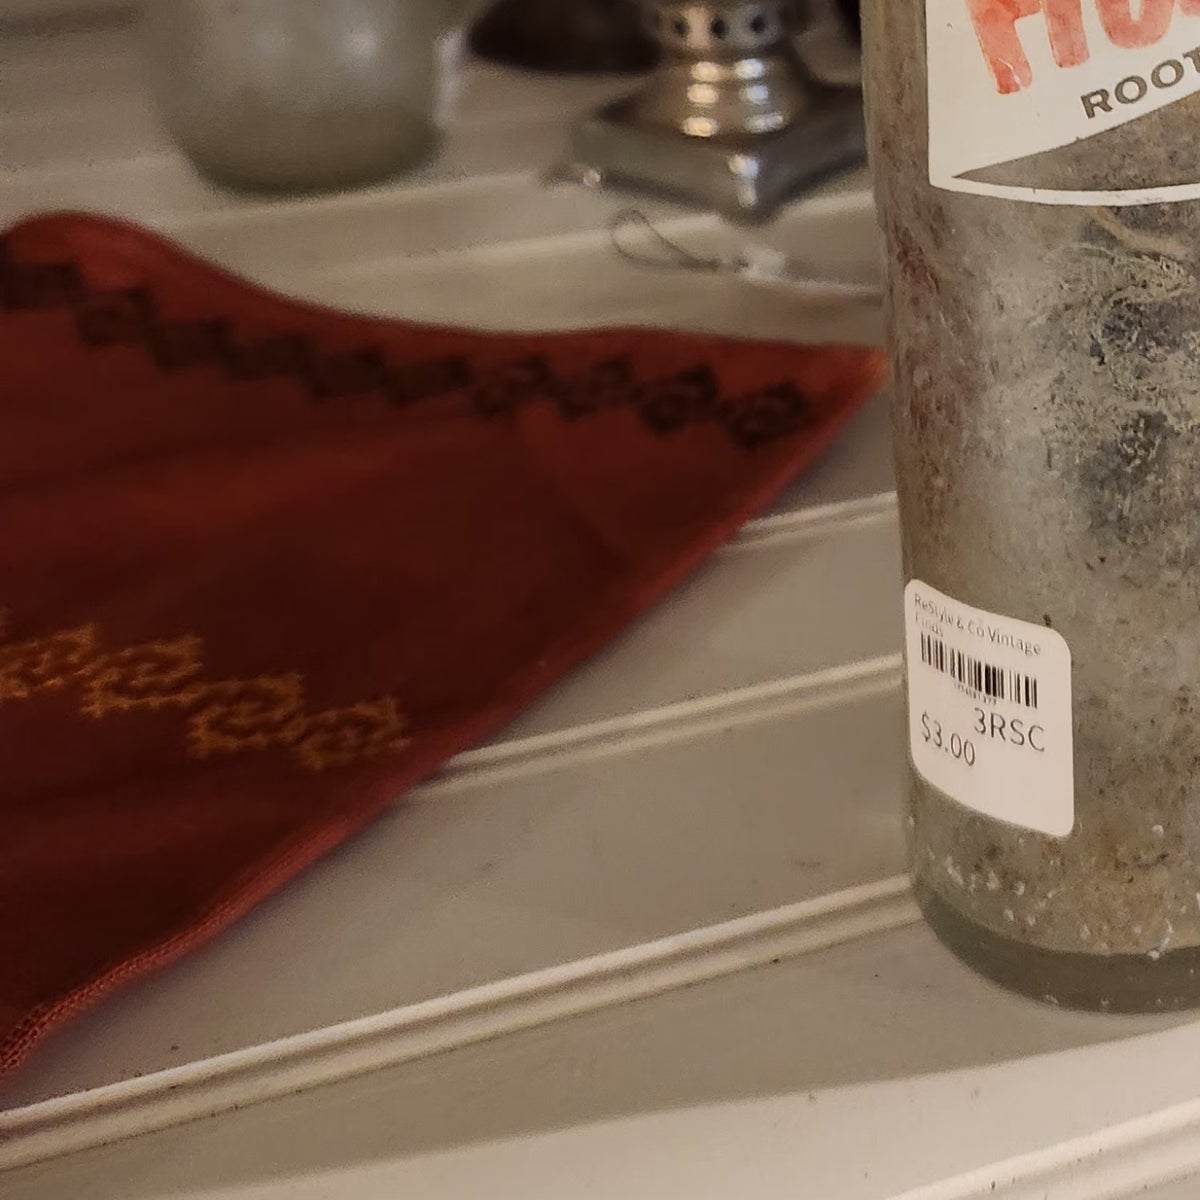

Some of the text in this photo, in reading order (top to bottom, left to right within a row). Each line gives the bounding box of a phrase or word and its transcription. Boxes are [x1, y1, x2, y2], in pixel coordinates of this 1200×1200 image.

[987, 625, 1042, 657] Vintage
[920, 710, 976, 768] $3.00
[973, 706, 1046, 753] 3RSC
